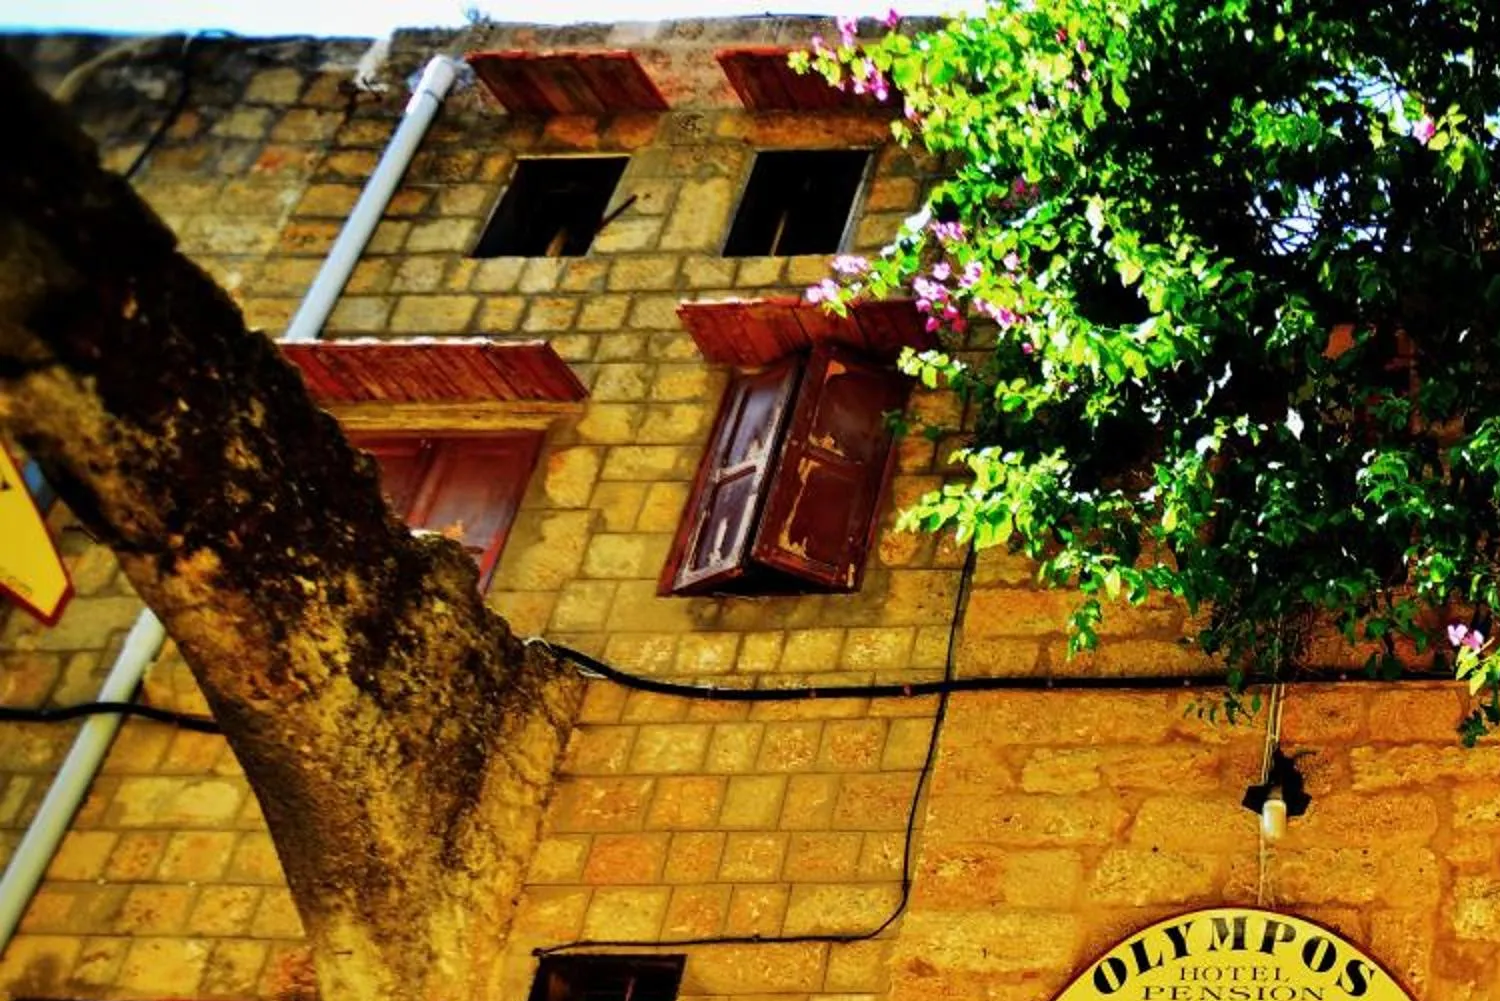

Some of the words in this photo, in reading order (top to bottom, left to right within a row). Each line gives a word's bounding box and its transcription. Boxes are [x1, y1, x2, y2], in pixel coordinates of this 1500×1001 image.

[1093, 915, 1375, 997] OLYMPOS
[1179, 966, 1291, 982] HOTEL
[1143, 985, 1325, 1001] PENSION
